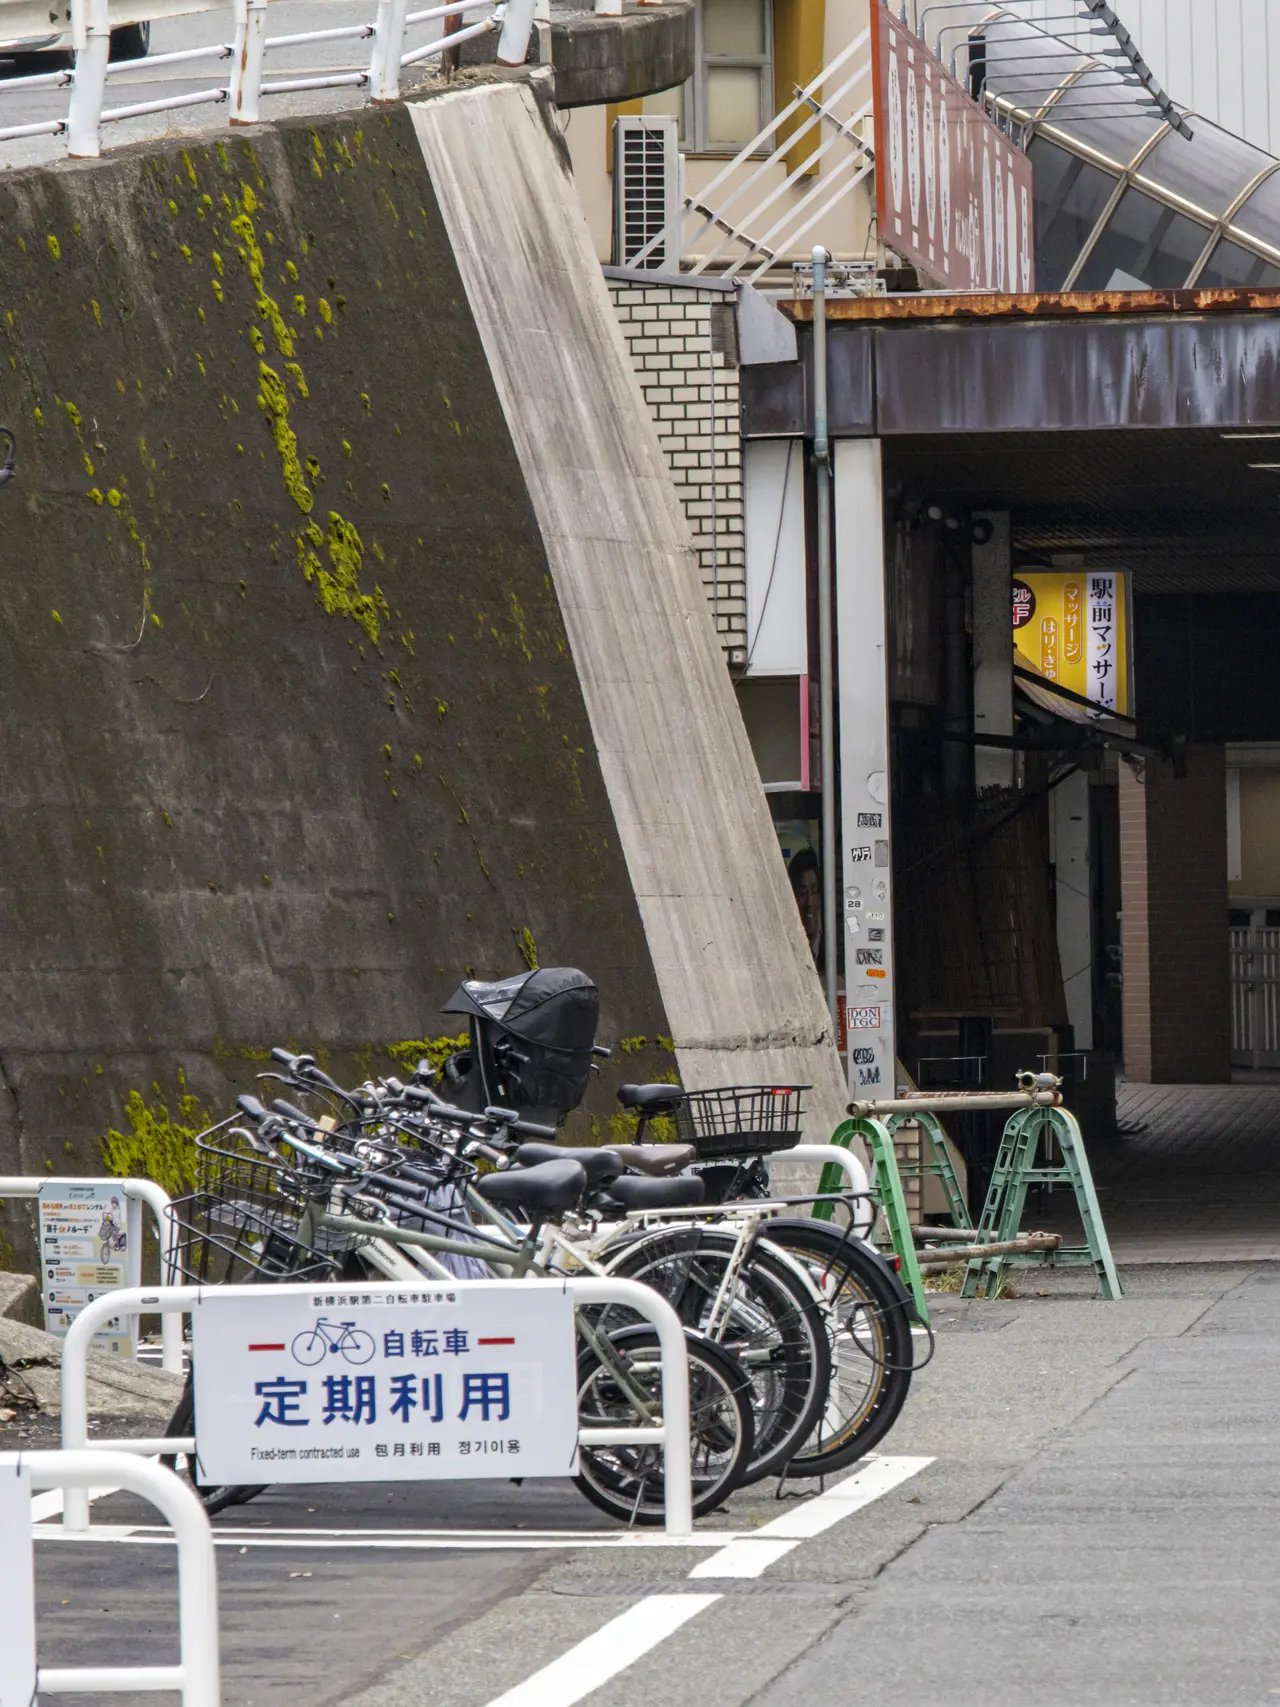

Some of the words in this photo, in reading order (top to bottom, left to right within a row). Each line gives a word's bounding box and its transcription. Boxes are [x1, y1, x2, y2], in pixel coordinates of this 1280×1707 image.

[1065, 587, 1080, 658] マッサージ
[847, 900, 861, 908] 28
[850, 1008, 877, 1018] DON
[383, 1327, 470, 1358] 自転車
[253, 1372, 510, 1428] 定期利用
[250, 1447, 297, 1461] Fixed-term
[298, 1445, 344, 1459] contracted
[345, 1446, 360, 1459] use
[374, 1442, 441, 1458] 包月利用
[458, 1438, 521, 1456] 정기이용
